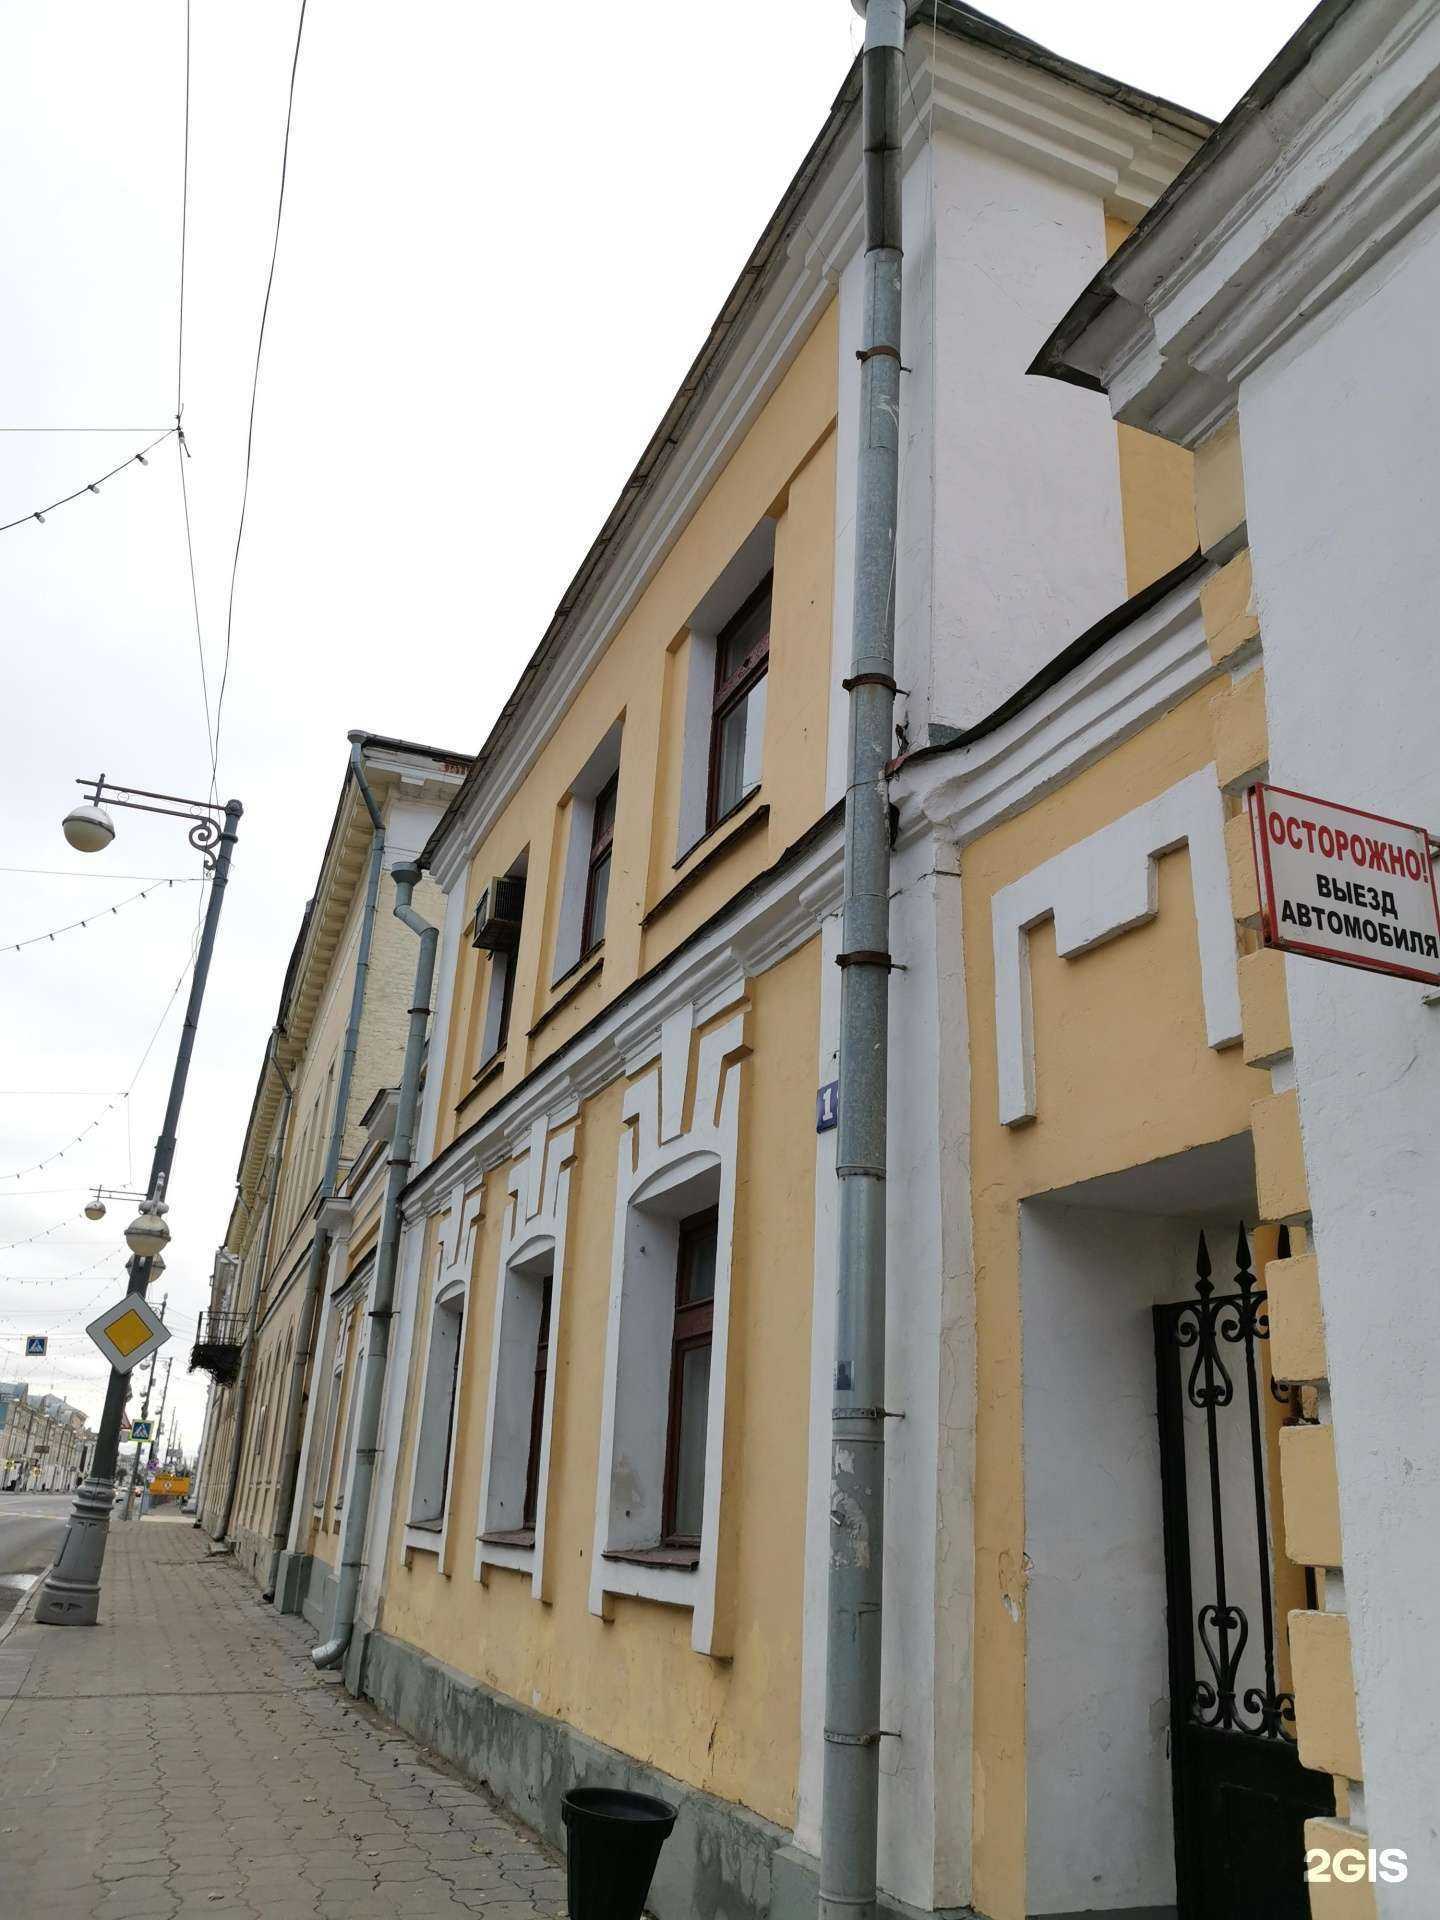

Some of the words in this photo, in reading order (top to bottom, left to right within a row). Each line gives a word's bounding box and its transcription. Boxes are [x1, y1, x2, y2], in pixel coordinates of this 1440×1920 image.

[1269, 811, 1429, 883] ОСТОРОЖНО!
[1316, 874, 1399, 920] ВЫЕЗД
[1281, 900, 1439, 959] АВТОМОБИЛЯ
